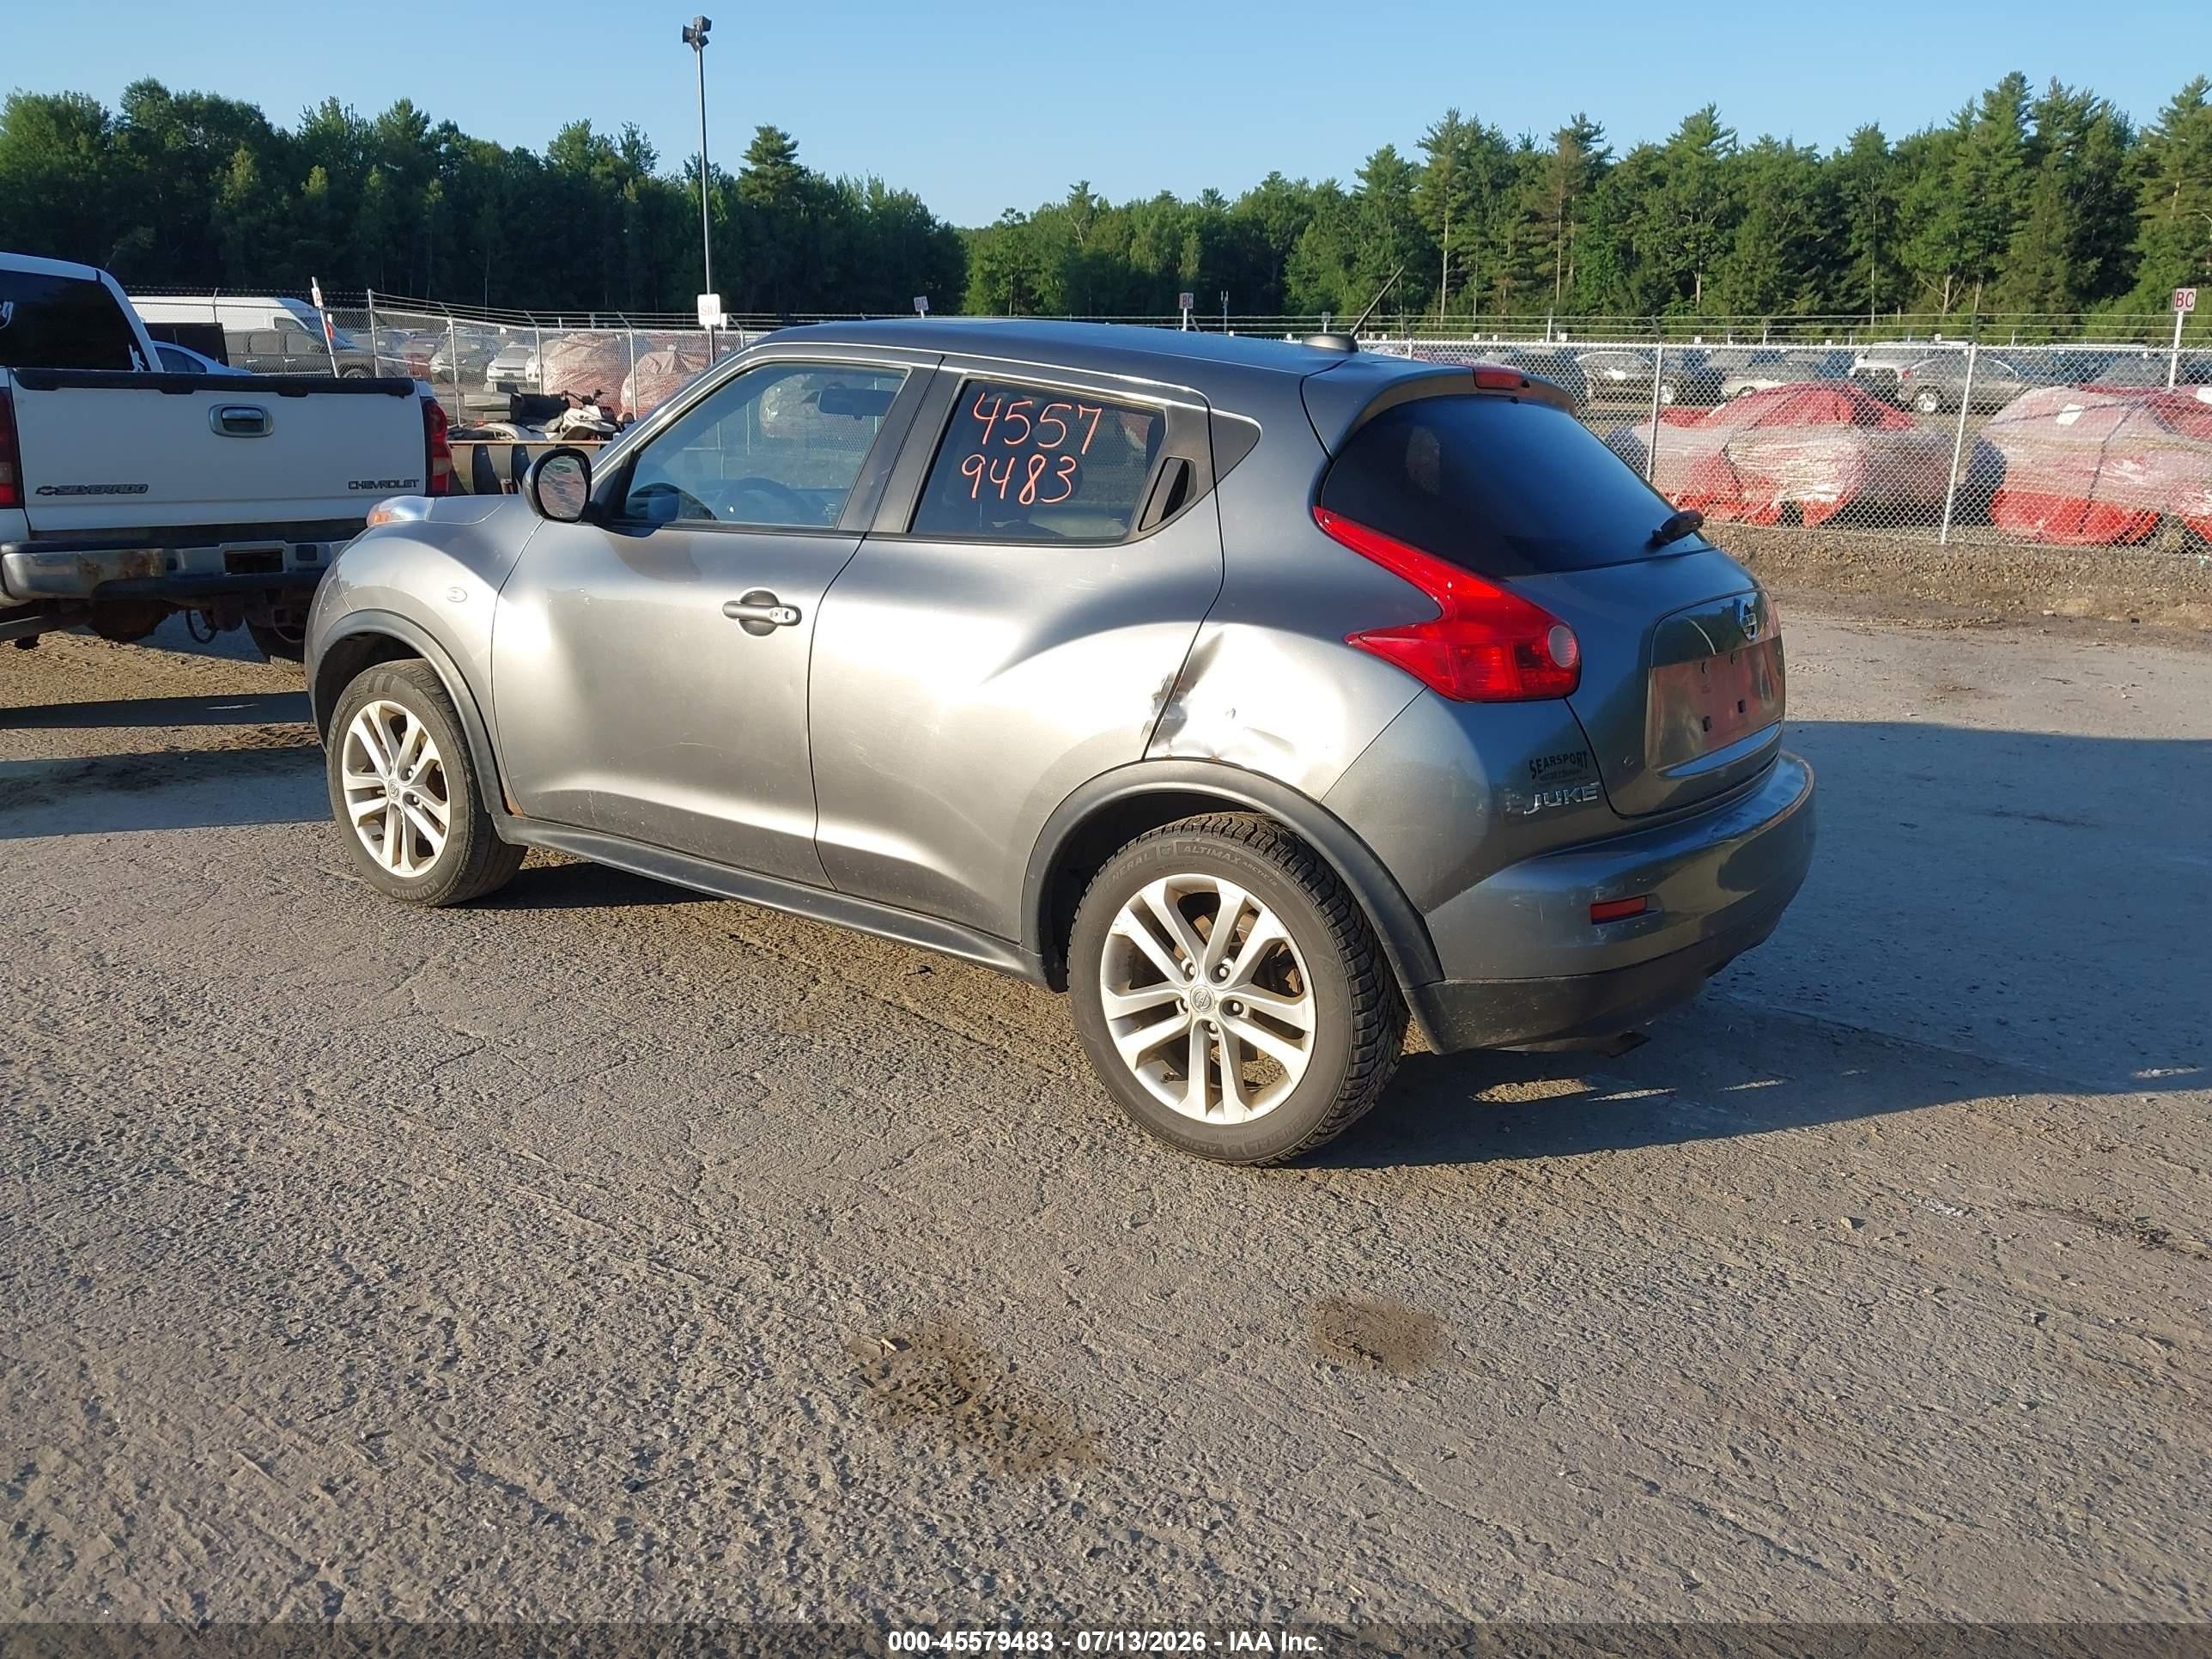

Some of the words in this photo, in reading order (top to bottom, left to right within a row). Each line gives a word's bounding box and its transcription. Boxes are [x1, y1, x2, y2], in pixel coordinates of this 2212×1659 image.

[315, 291, 322, 303] A
[2175, 291, 2195, 307] BC
[972, 392, 1103, 455] 4557
[56, 483, 149, 495] SILVERADO
[348, 479, 419, 489] CHEVROLET
[961, 453, 1077, 505] 9483
[1529, 750, 1588, 780] SEARSPORT
[1523, 781, 1600, 815] JUKE
[1182, 845, 1242, 866] ALTIMAX
[391, 878, 439, 900] KUMHO
